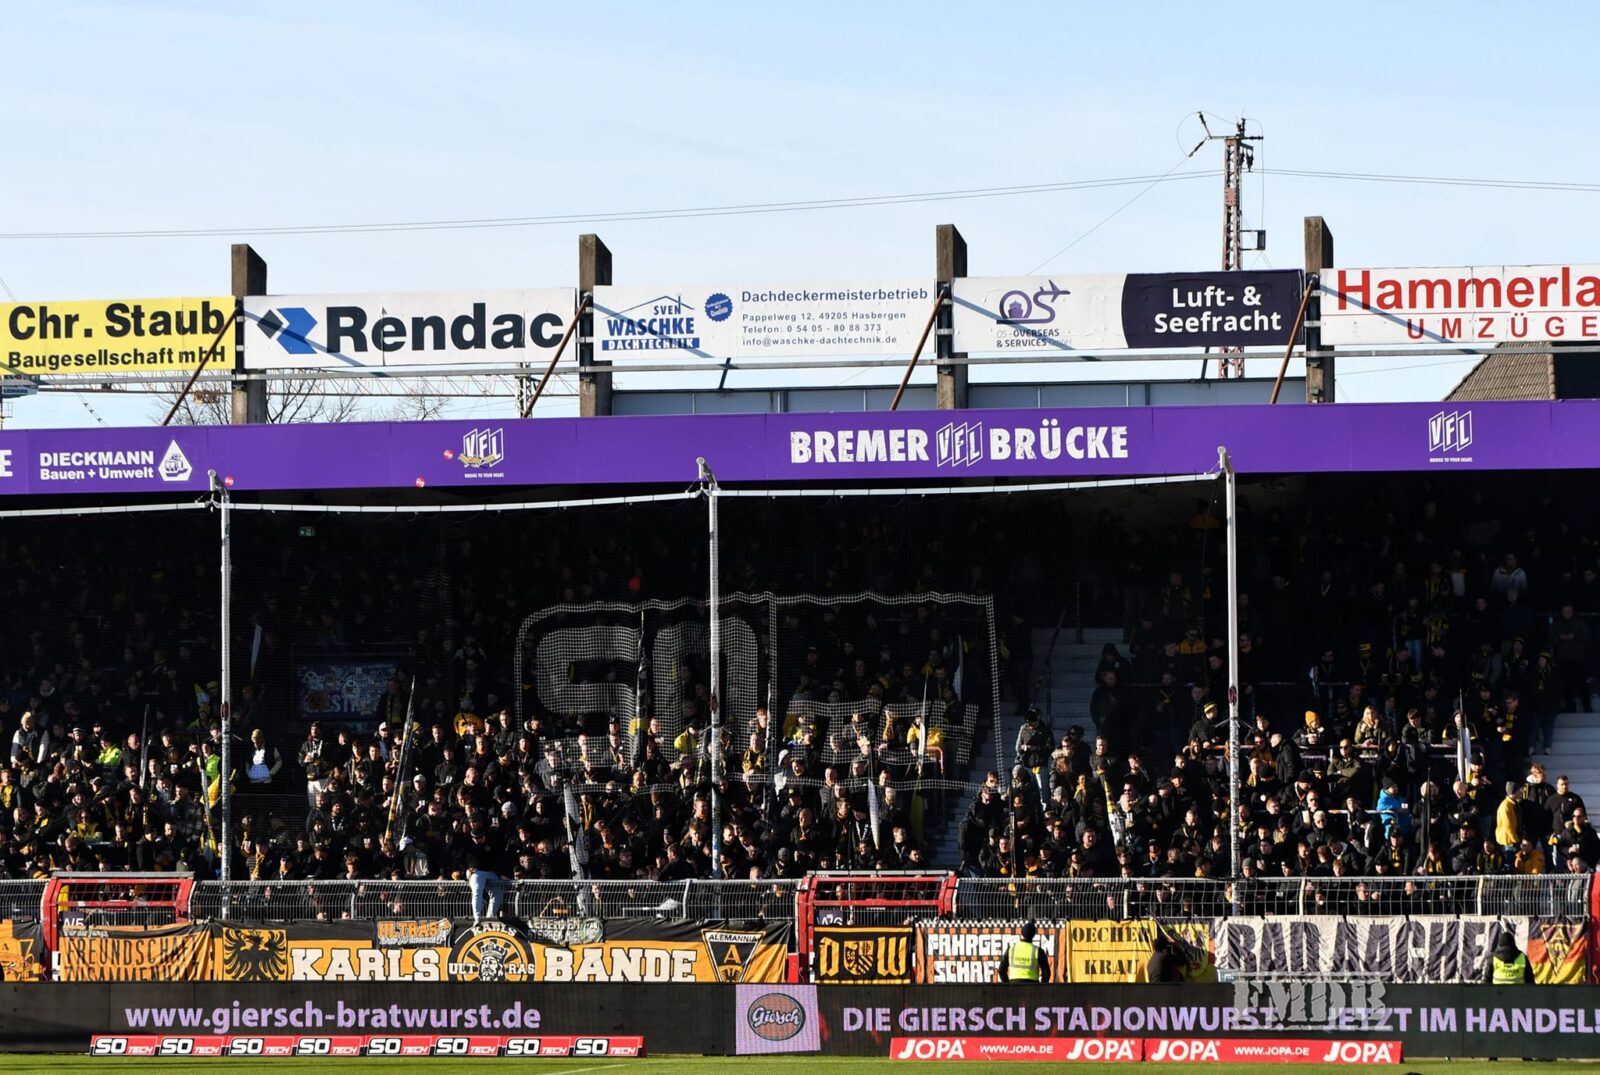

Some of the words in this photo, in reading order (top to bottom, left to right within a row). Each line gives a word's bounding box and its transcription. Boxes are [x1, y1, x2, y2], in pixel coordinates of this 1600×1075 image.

[741, 288, 928, 303] Dachdeckermeisterbetrieb
[1171, 286, 1234, 308] Luft-
[1242, 286, 1262, 306] &
[1337, 267, 1600, 310] Hammerla
[653, 304, 681, 316] SVEN
[742, 313, 797, 322] Pappelweg
[801, 313, 815, 321] 12,
[819, 312, 848, 320] 49205
[851, 311, 906, 321] Hasbergen
[8, 305, 93, 340] Chr.
[105, 301, 225, 337] Staub
[326, 302, 564, 352] Rendac
[607, 317, 695, 336] WASCHKE
[742, 326, 783, 334] Telefon:
[833, 324, 845, 332] 80
[1154, 310, 1282, 335] Seefracht
[1407, 313, 1599, 340] UMZÜGE
[742, 336, 897, 347] info@waschke-dachtechnik.de
[1013, 328, 1060, 338] OVERSEAS
[608, 338, 694, 350] DACHTECHNIK
[1005, 339, 1047, 348] SERVICES
[8, 347, 173, 370] Baugesellschaft
[1429, 413, 1471, 450] VFL
[464, 430, 503, 464] VFL
[789, 429, 930, 464] BREMER
[937, 424, 982, 465] VFL
[989, 418, 1129, 461] BRÜCKE
[39, 450, 154, 467] DIECKMANN
[40, 467, 85, 480] Bauen
[98, 466, 154, 479] Umwelt
[471, 920, 517, 937] KARLS
[709, 933, 758, 942] ALEMANNIA
[291, 948, 440, 981] KARLS
[543, 947, 698, 982] BANDE
[933, 960, 1002, 983] SCHAF
[124, 1000, 541, 1034] www.giersch-bratwurst.de
[751, 1006, 801, 1027] Giersch
[843, 1007, 891, 1032] DIE
[899, 1007, 1026, 1032] GIERSCH
[1034, 1006, 1284, 1032] STADIONWURST.
[1328, 1007, 1412, 1033] JETZT
[1419, 1007, 1457, 1032] IM
[1465, 1008, 1600, 1034] HANDEL!
[95, 1038, 127, 1055] SO
[128, 1045, 153, 1055] TECH
[161, 1038, 193, 1055] SO
[194, 1045, 219, 1055] TECH
[231, 1038, 264, 1055] SO
[265, 1045, 290, 1055] TECH
[298, 1038, 330, 1055] SO
[332, 1045, 357, 1055] TECH
[369, 1038, 401, 1055] SO
[402, 1045, 428, 1055] TECH
[434, 1038, 467, 1055] SO
[470, 1045, 495, 1055] TECH
[508, 1038, 540, 1055] SO
[541, 1045, 567, 1055] TECH
[575, 1038, 608, 1055] SO
[610, 1045, 635, 1055] TECH
[898, 1039, 967, 1059] JOPA
[980, 1045, 1053, 1054] WWW.JOPA.DE
[1066, 1039, 1135, 1060] JOPA
[1151, 1040, 1220, 1061] JOPA
[1234, 1046, 1310, 1056] WWW.JOPA.DE
[1323, 1042, 1393, 1063] JOPA
